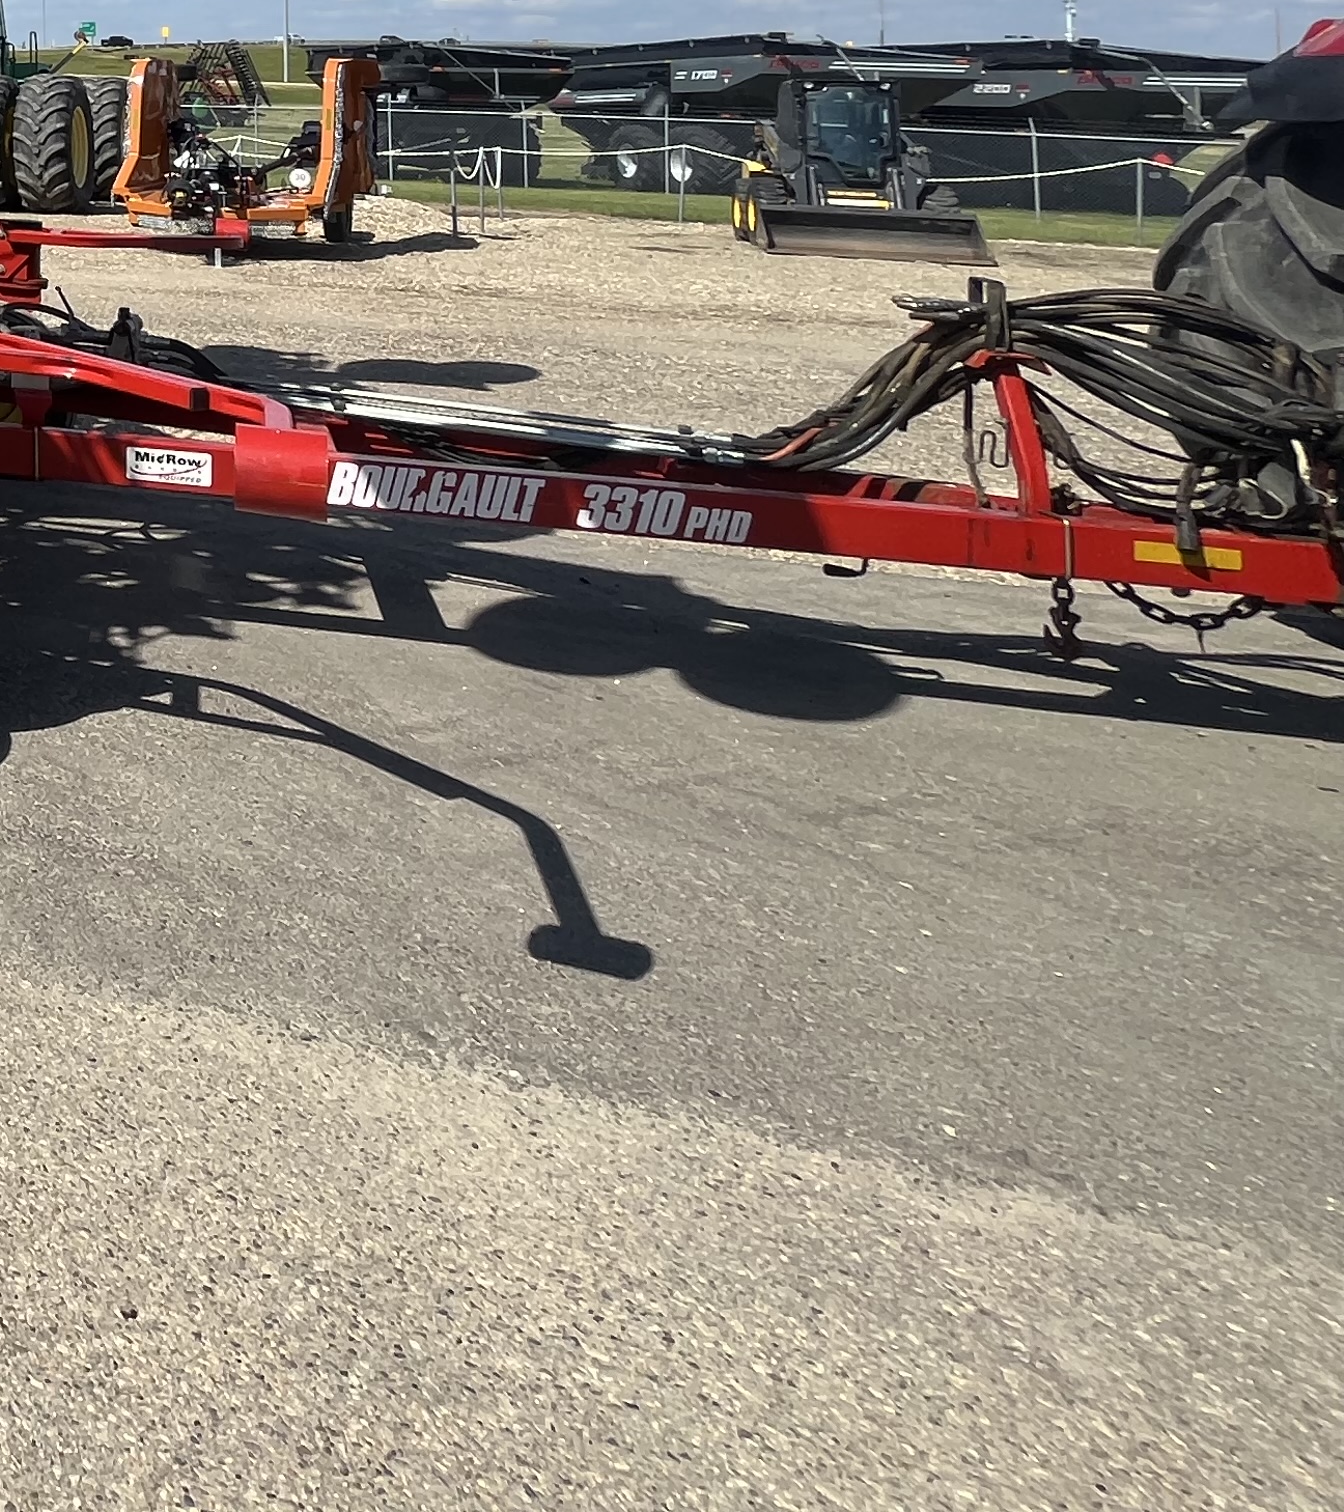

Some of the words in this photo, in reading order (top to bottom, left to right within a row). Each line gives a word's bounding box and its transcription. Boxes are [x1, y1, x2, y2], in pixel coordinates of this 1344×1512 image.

[134, 450, 202, 468] MidRow
[326, 459, 546, 524] BOURGAULT
[576, 482, 687, 538] 3310
[683, 506, 753, 544] PHD
